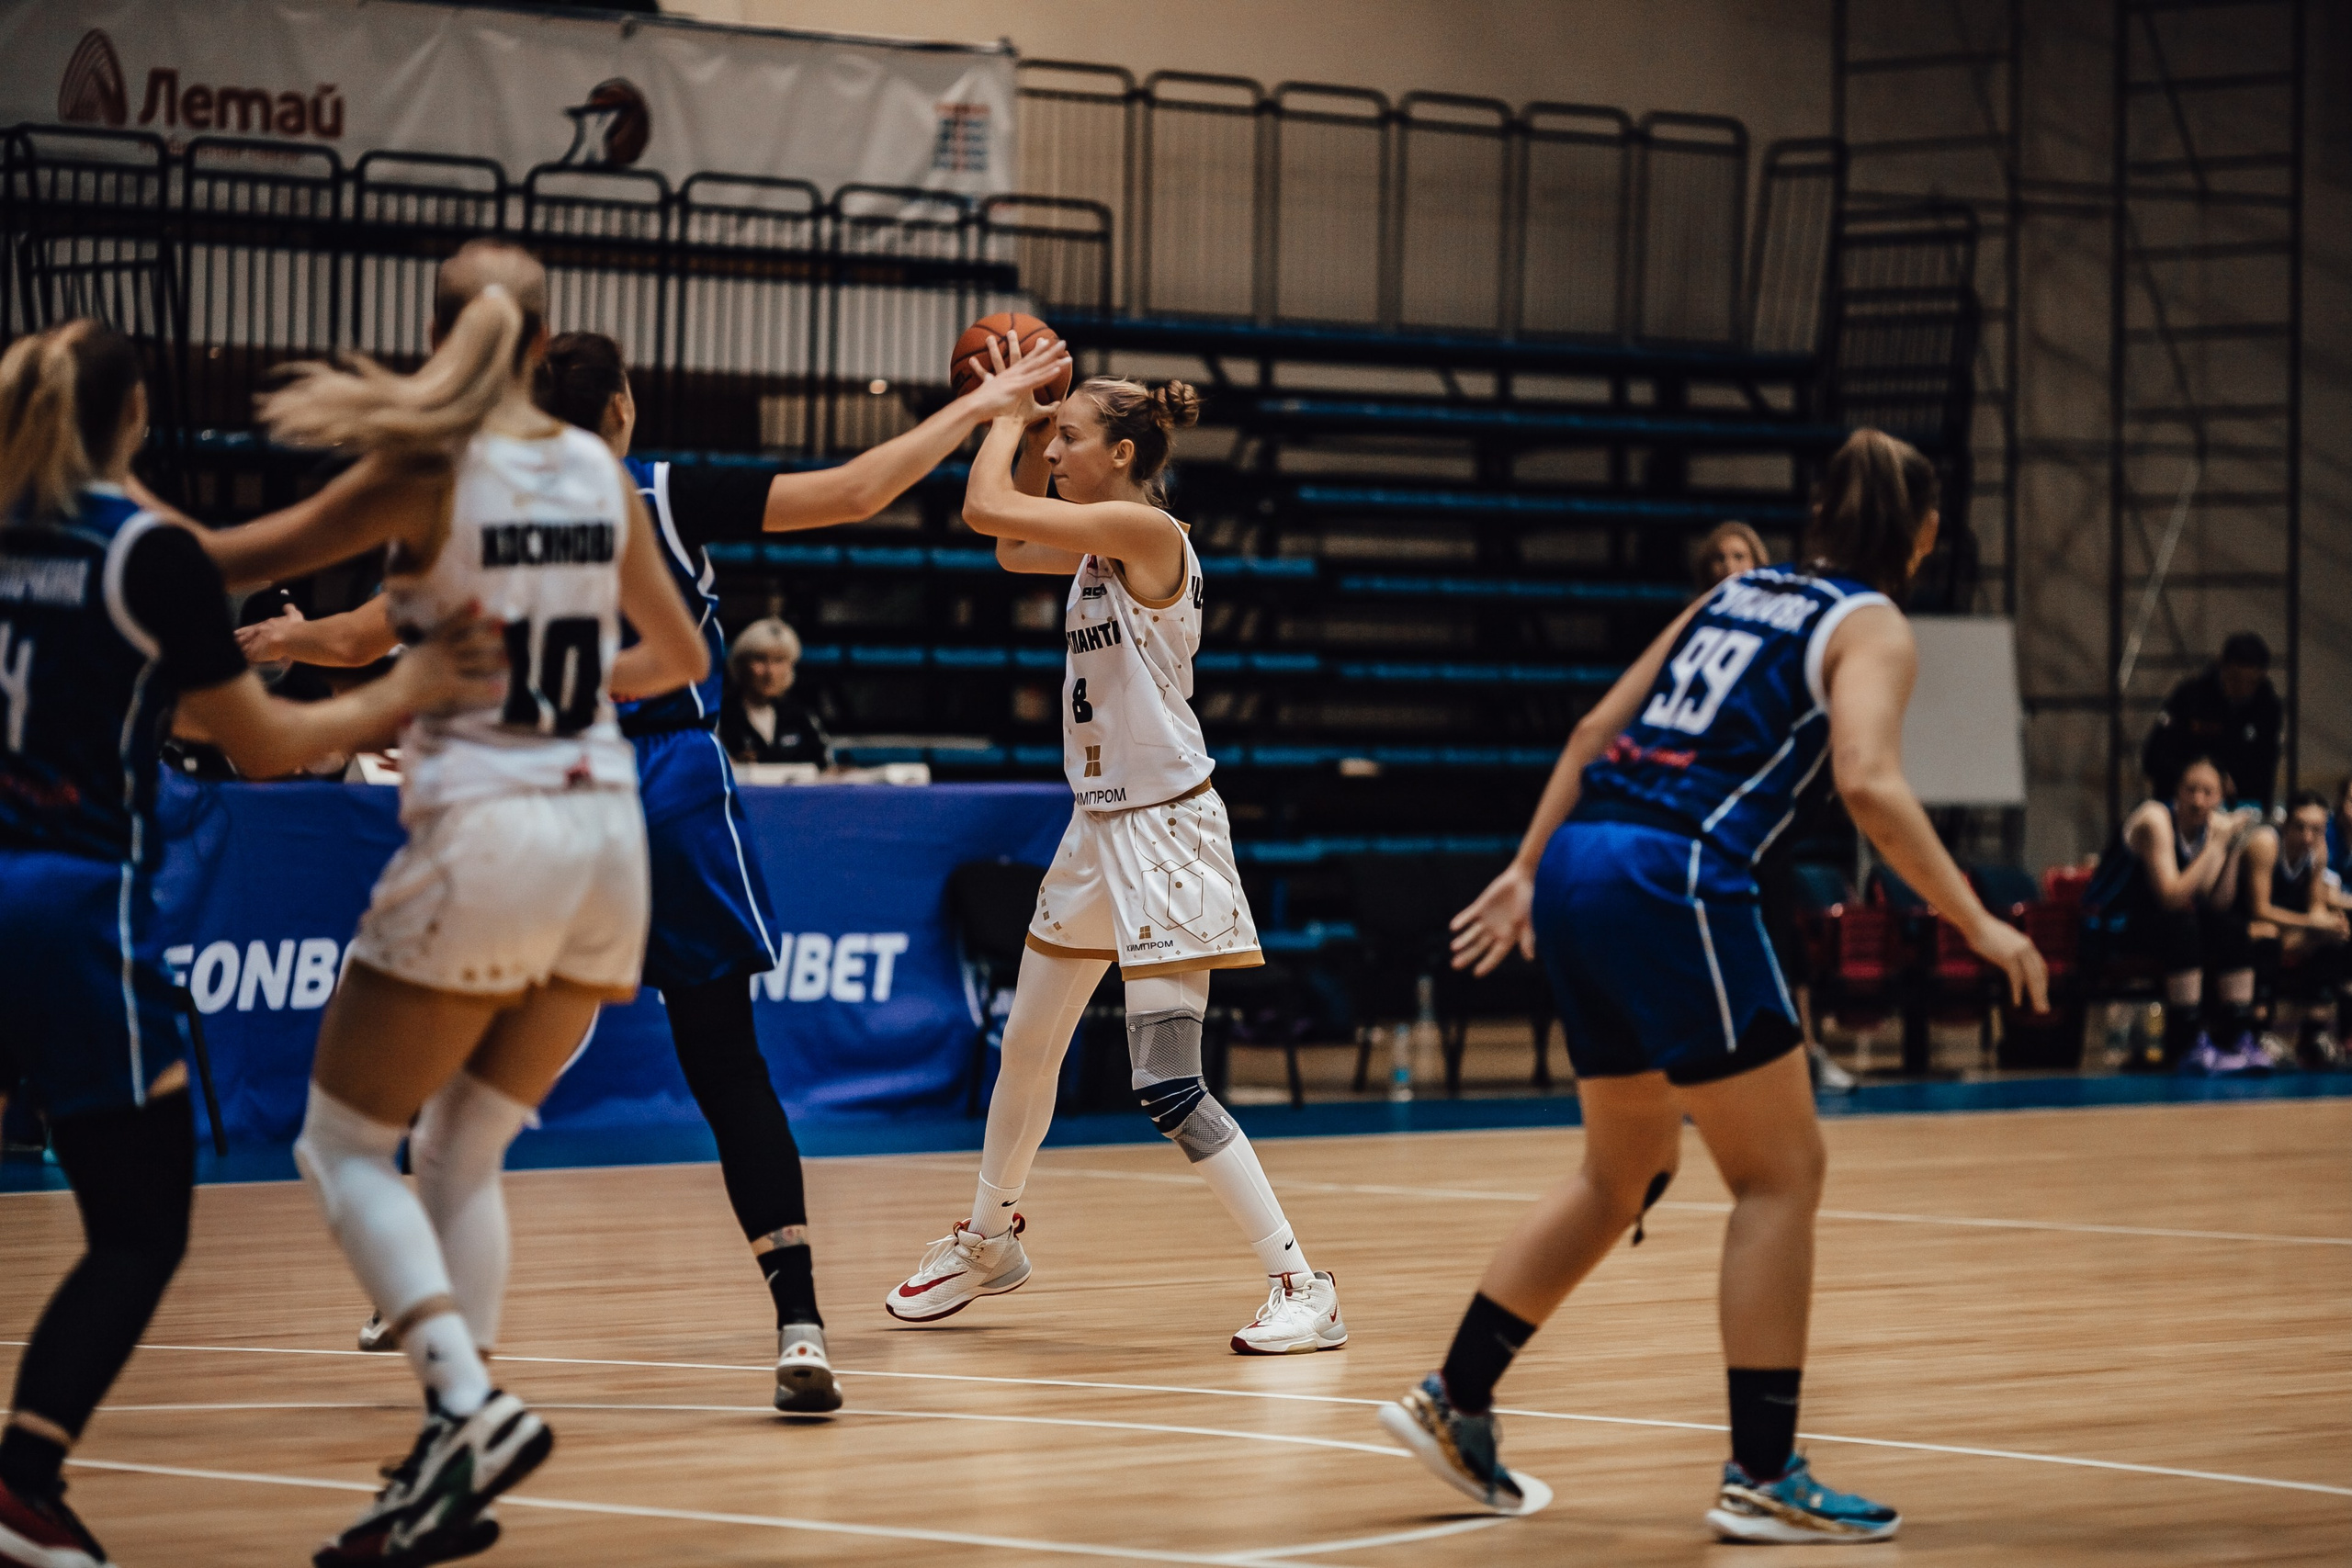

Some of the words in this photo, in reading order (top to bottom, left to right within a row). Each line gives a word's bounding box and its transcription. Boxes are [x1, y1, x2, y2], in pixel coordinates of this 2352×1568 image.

[139, 67, 345, 138] Летай
[503, 616, 602, 736] 10
[1641, 626, 1764, 735] 99
[1125, 939, 1174, 953] ХИМПРОМ
